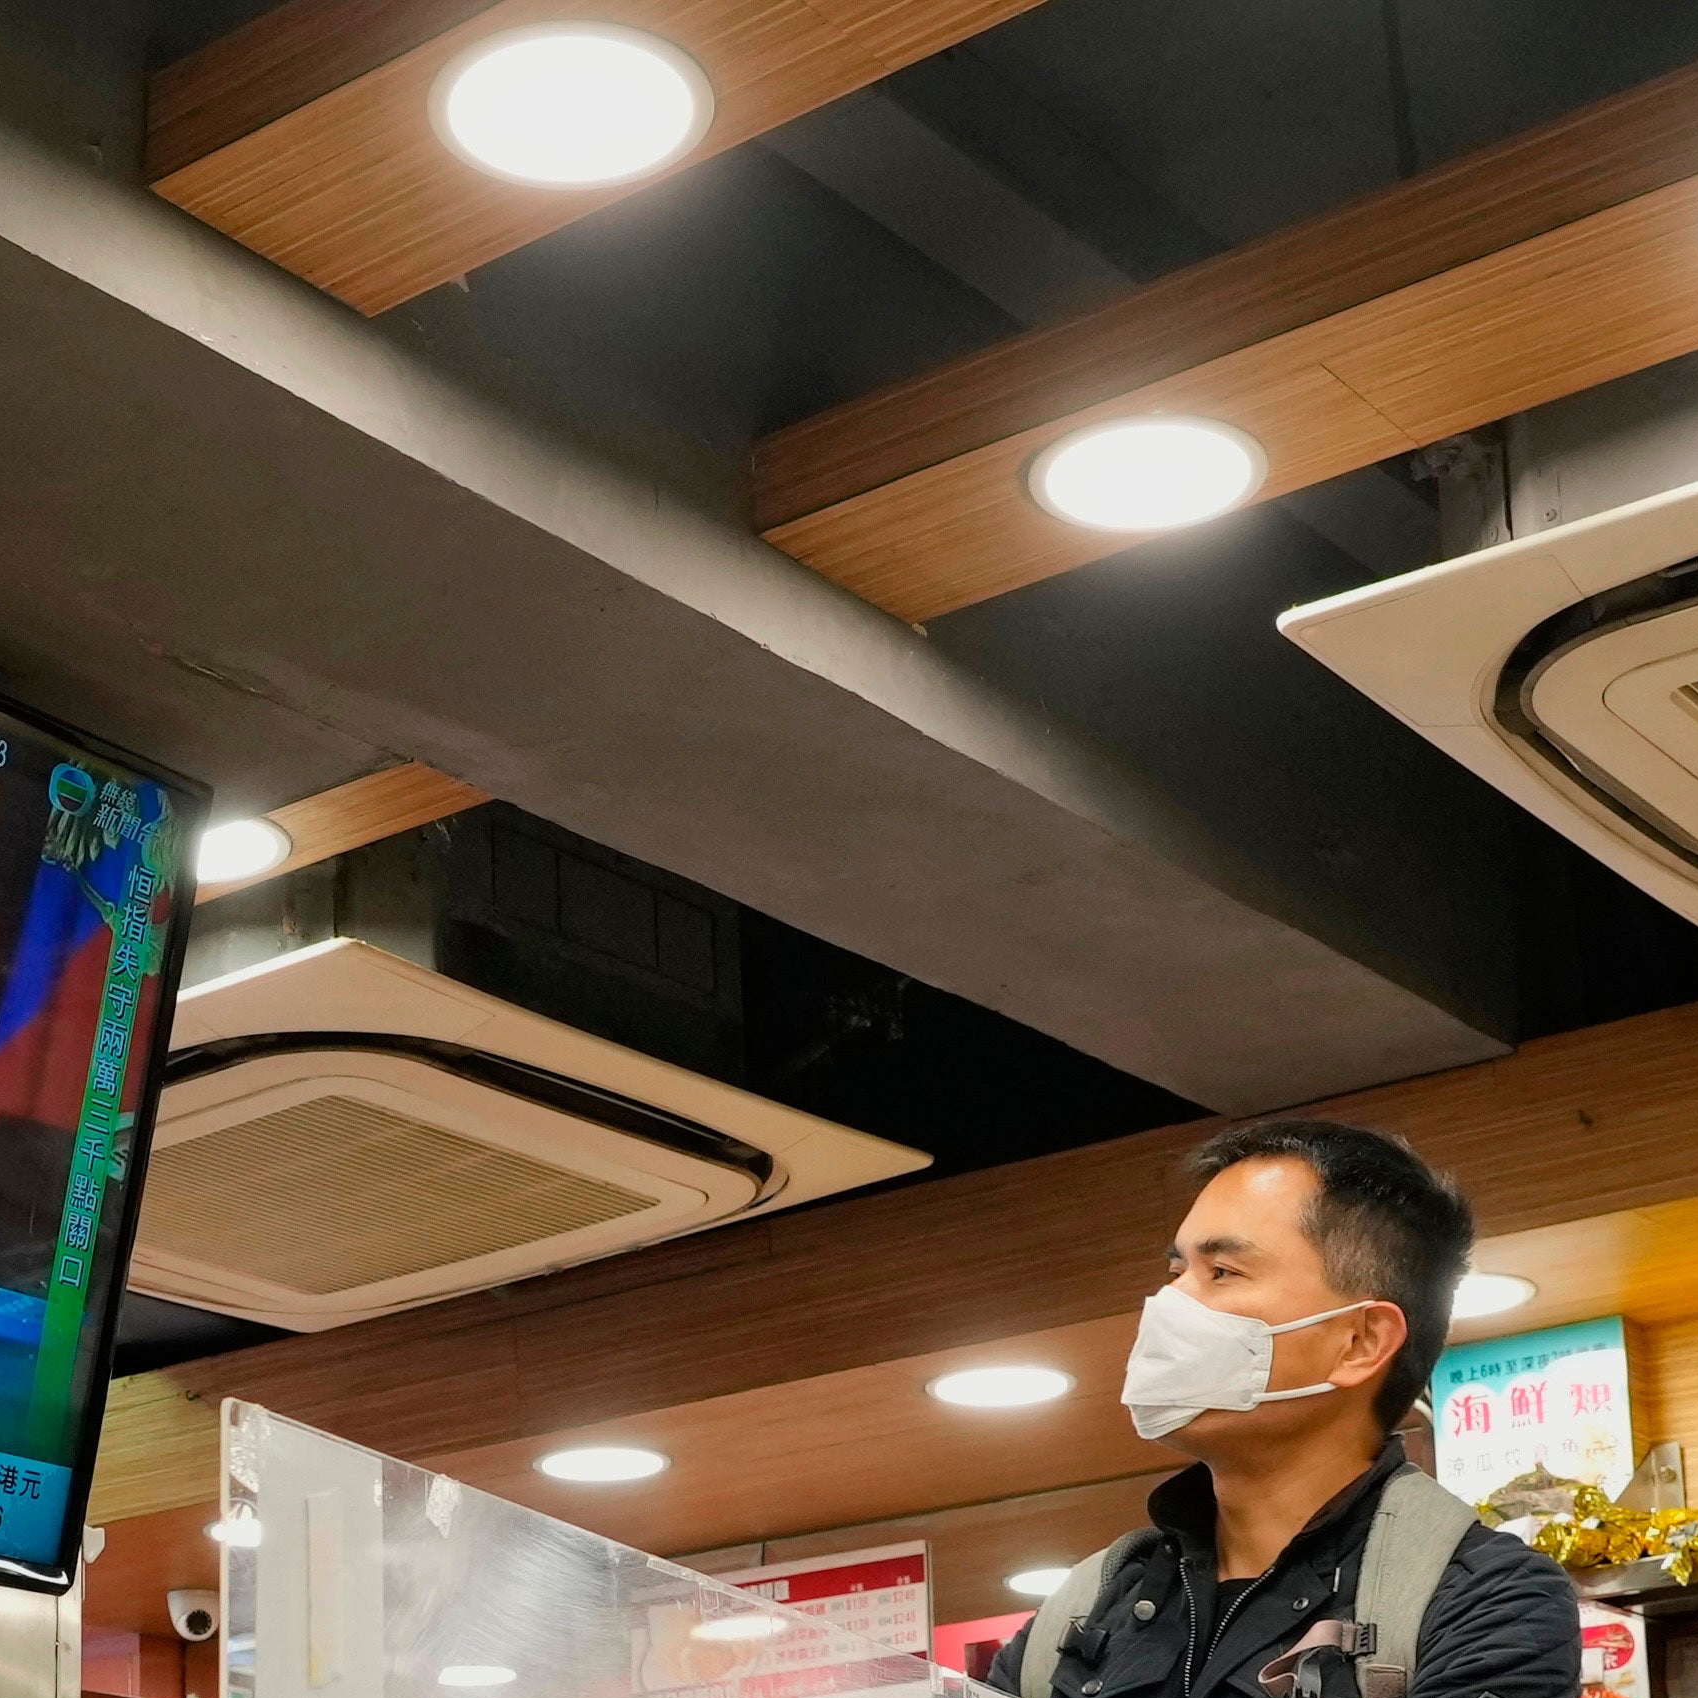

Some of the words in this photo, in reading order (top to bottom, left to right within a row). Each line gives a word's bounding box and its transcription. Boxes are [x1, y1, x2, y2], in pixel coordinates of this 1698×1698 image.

[58, 863, 155, 1289] 恒指失守兩萬三千點關口
